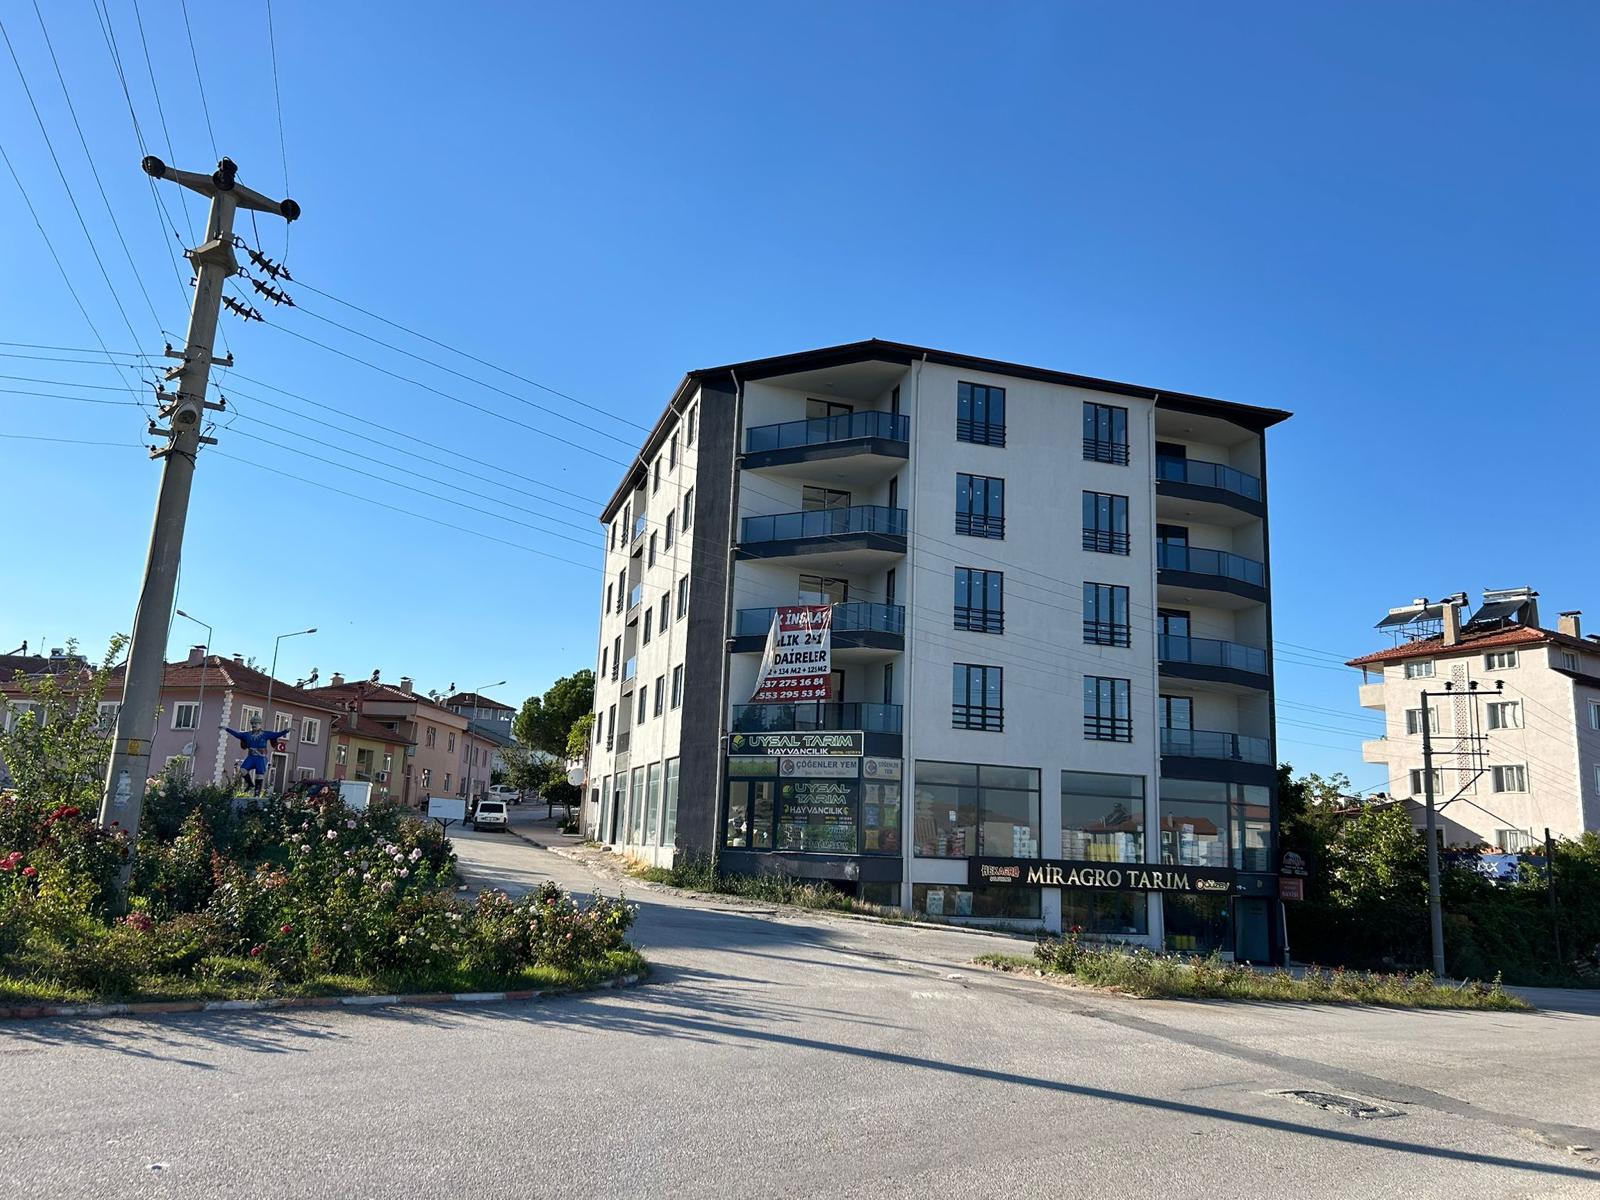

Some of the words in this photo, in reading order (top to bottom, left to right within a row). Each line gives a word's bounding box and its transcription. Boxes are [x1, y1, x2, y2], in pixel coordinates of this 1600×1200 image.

[774, 649, 827, 665] DAİRELER
[779, 679, 798, 687] 275
[799, 678, 811, 686] 16
[780, 690, 799, 699] 295
[801, 689, 813, 698] 53
[748, 735, 801, 747] UYSAL
[802, 735, 853, 747] TARIM
[796, 759, 838, 769] ÇÖĞENLER
[840, 760, 857, 768] YEM
[794, 783, 851, 793] UYSAL
[794, 794, 847, 804] TARIM
[789, 806, 843, 815] HAYVANCILIK
[1026, 863, 1121, 887] MİRAGRO
[1126, 870, 1191, 890] TARIM
